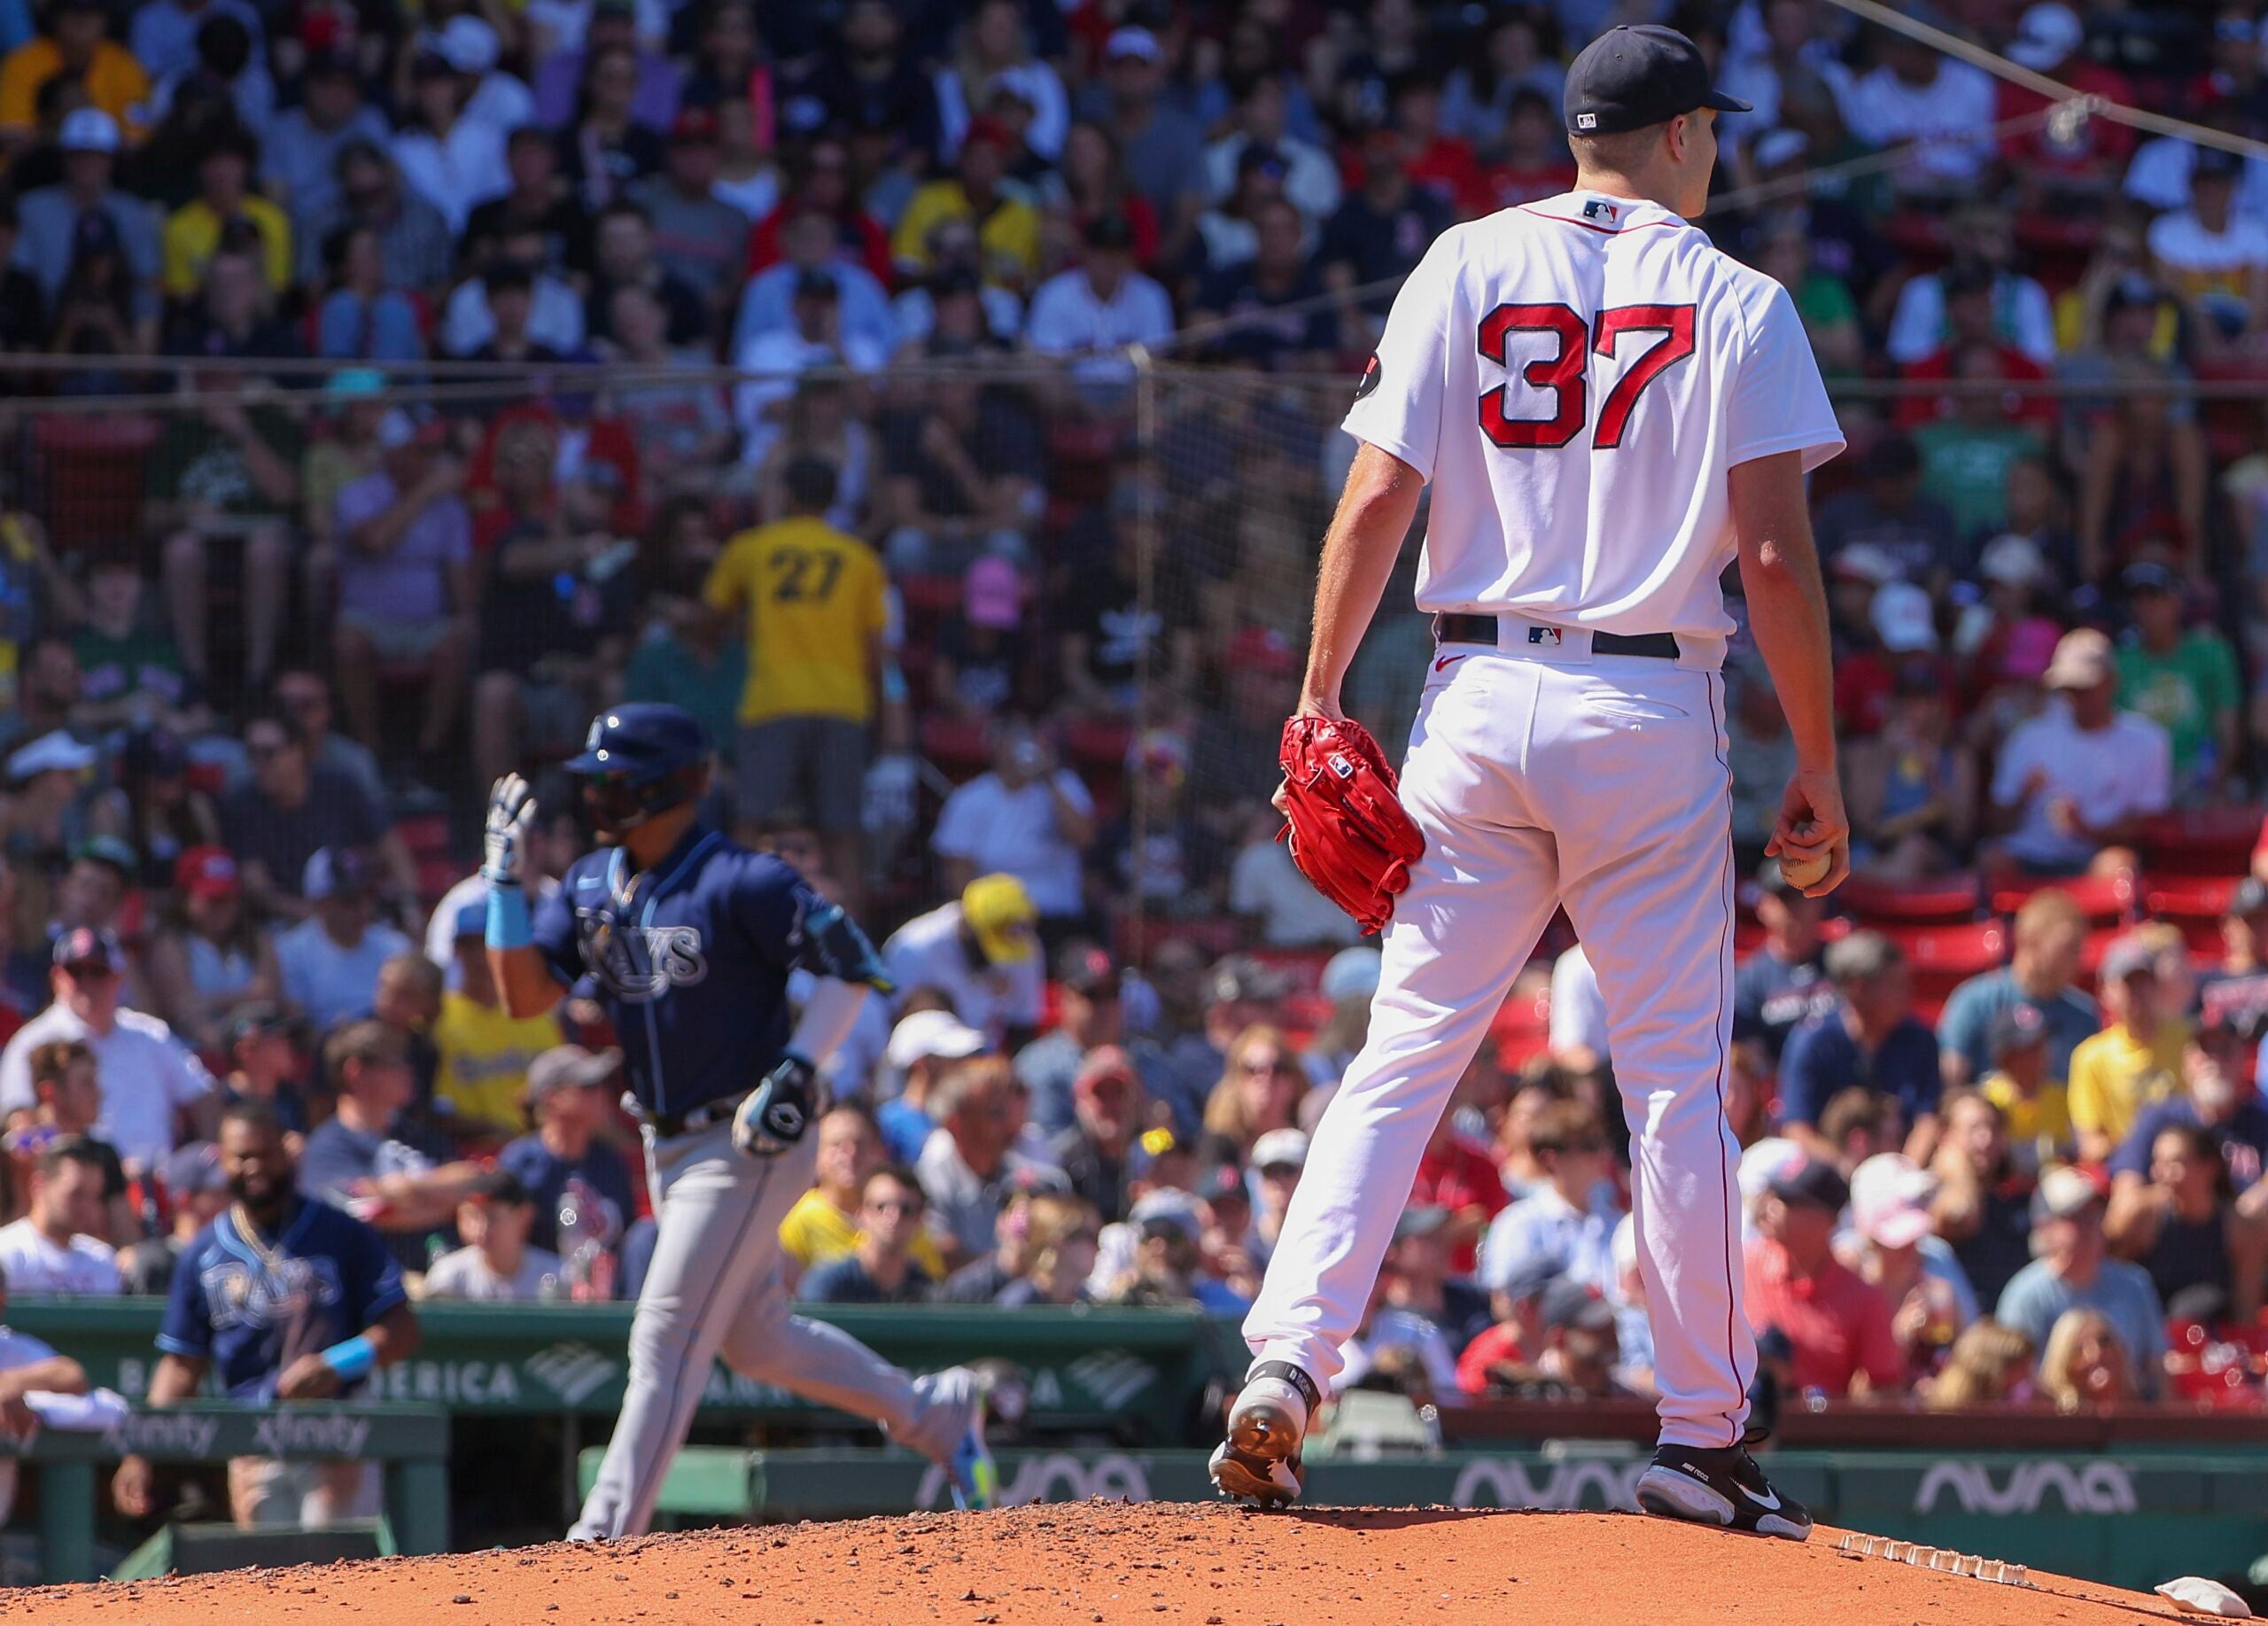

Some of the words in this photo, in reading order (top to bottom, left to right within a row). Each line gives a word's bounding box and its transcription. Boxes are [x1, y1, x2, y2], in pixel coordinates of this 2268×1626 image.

[1477, 302, 1697, 450] 37
[768, 543, 846, 603] 27
[1915, 1462, 2137, 1514] nuna
